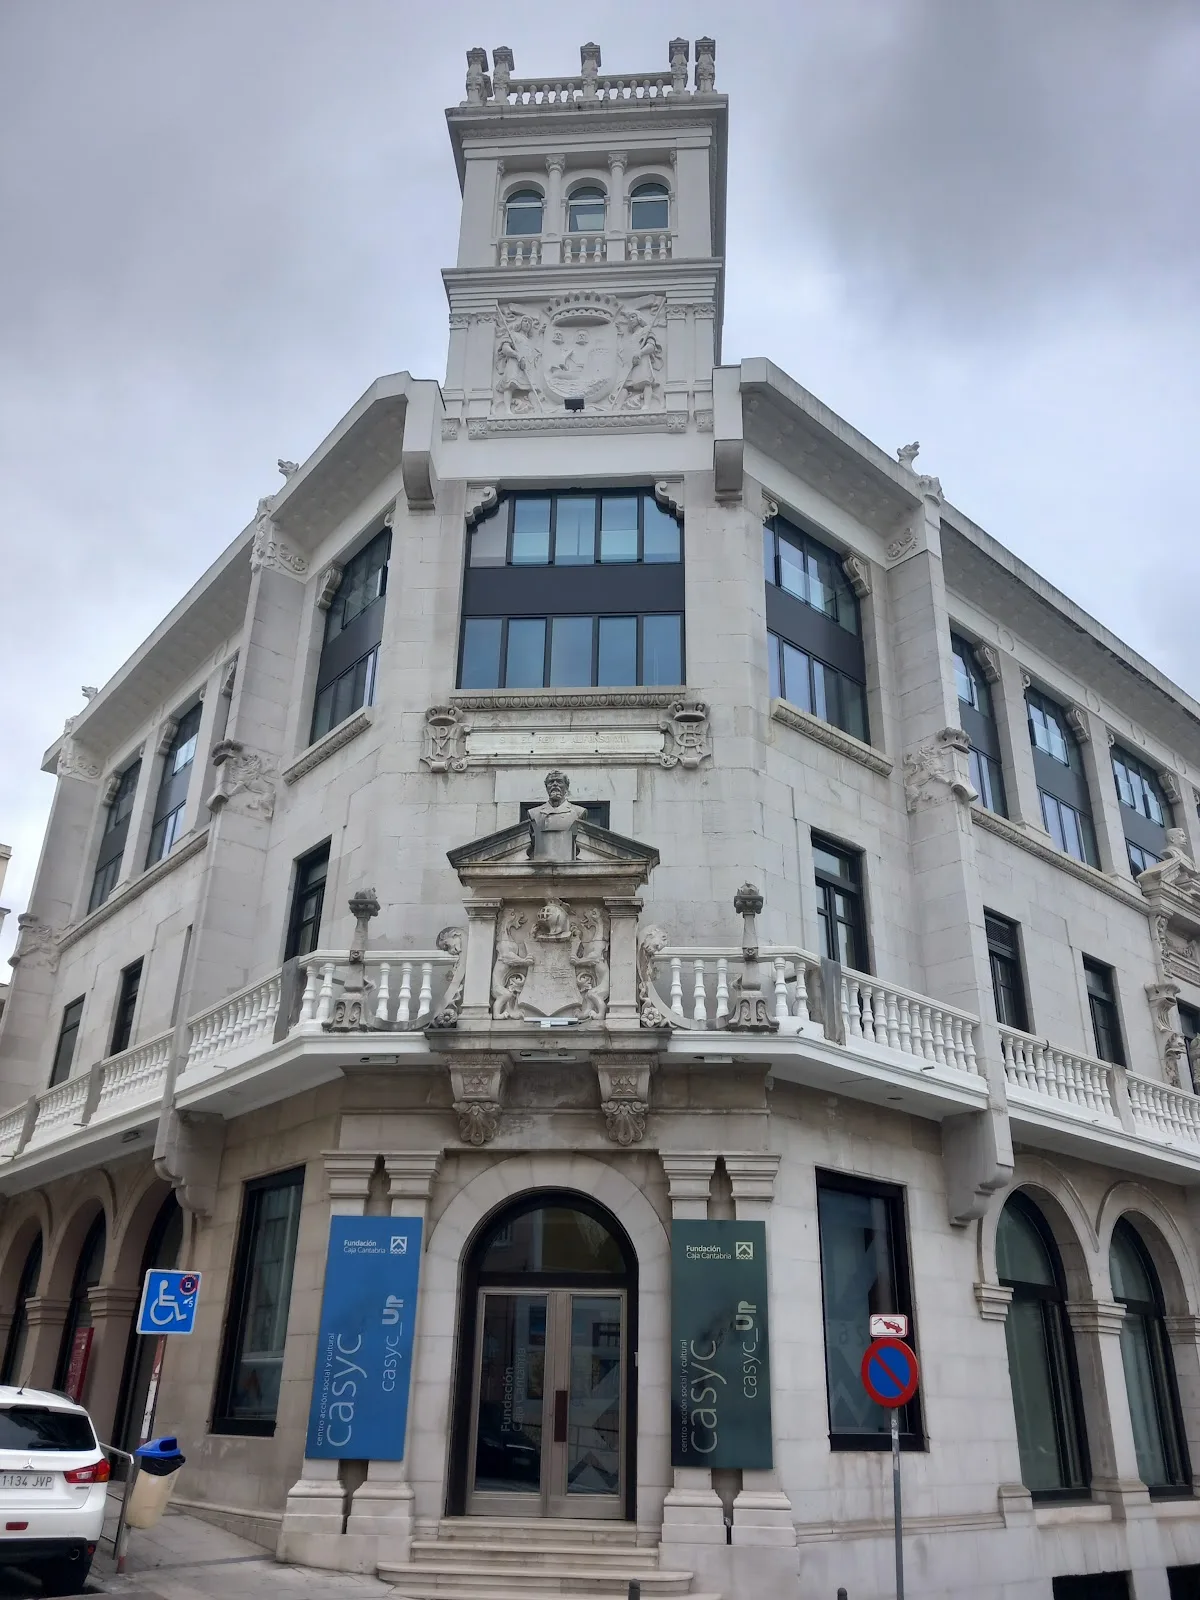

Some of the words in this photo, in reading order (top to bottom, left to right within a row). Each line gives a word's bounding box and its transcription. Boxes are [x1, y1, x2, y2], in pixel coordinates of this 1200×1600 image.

[343, 1239, 377, 1247] Fundación
[343, 1246, 357, 1254] Caja
[357, 1246, 386, 1254] Cantabria
[686, 1244, 721, 1252] Fundación
[686, 1251, 700, 1260] Caja
[701, 1252, 732, 1260] Cantabria
[326, 1332, 335, 1361] cultural
[680, 1339, 688, 1368] cultural
[323, 1369, 331, 1391] social
[326, 1333, 368, 1447] casyc
[680, 1376, 688, 1397] social
[320, 1392, 328, 1419] acción
[500, 1366, 514, 1432] Fundación
[690, 1339, 728, 1454] casyc
[680, 1399, 688, 1425] acción
[316, 1420, 325, 1446] centro
[3, 1475, 28, 1487] 1134
[32, 1475, 53, 1487] JVP
